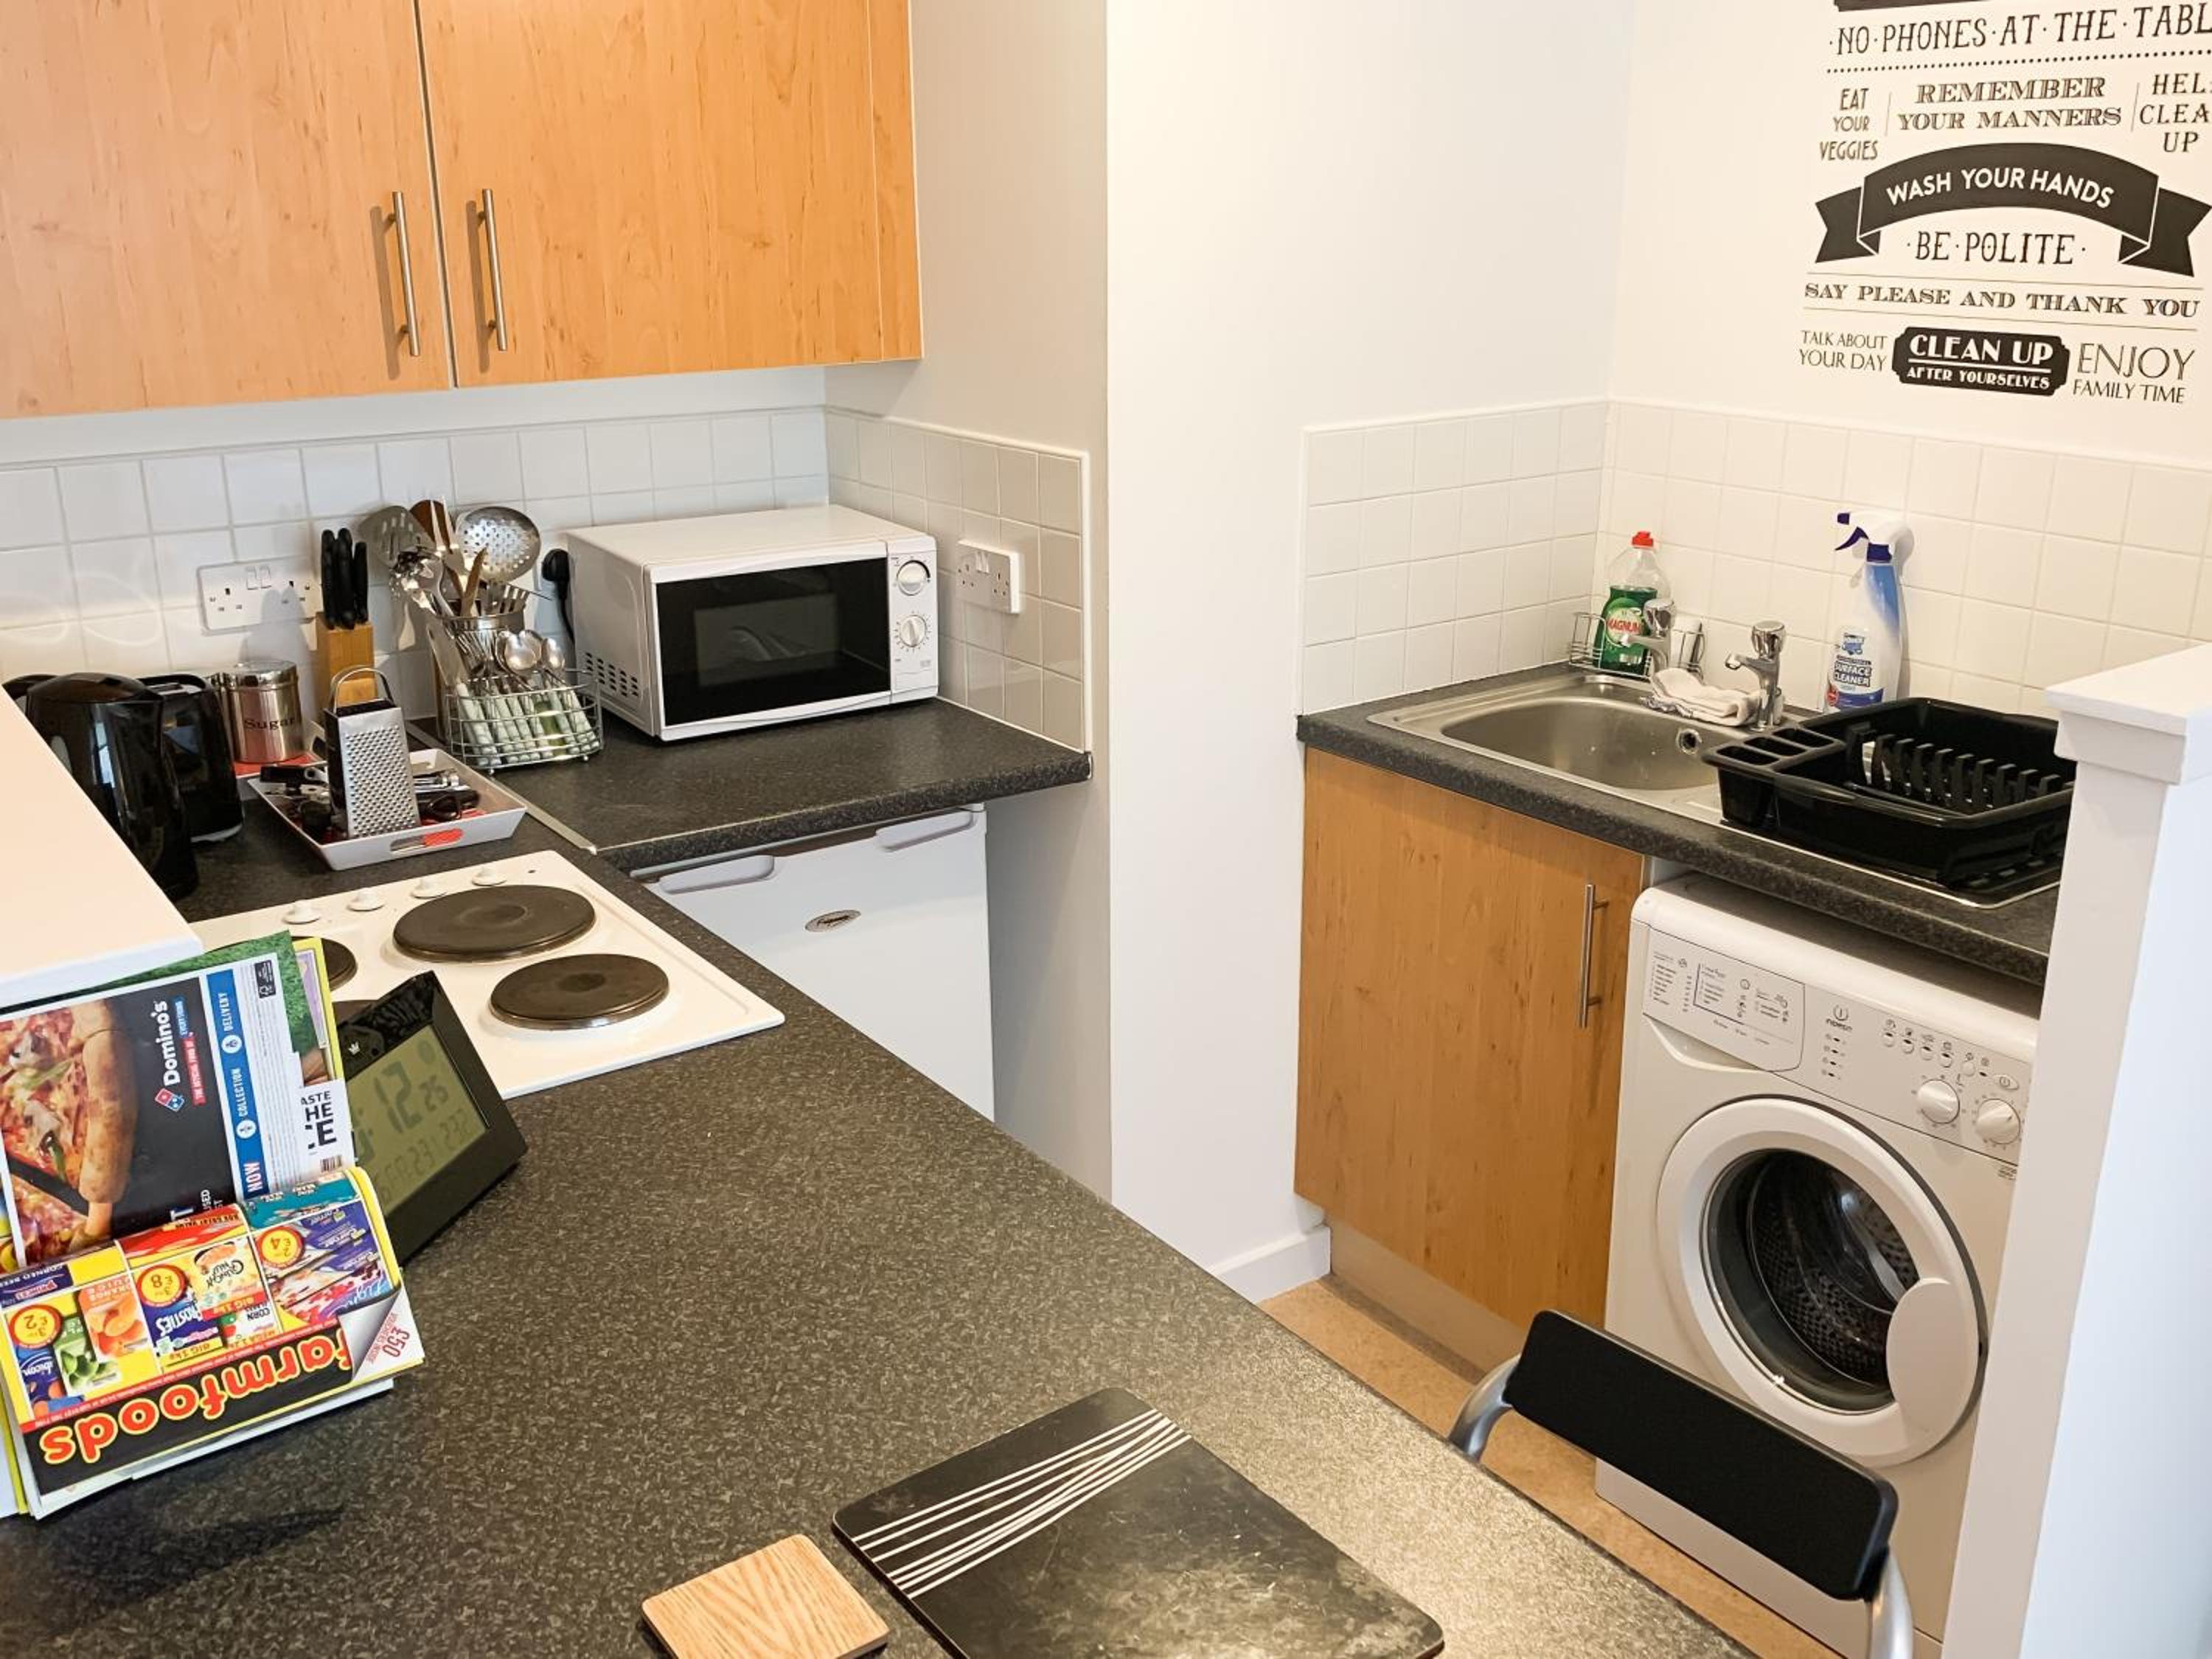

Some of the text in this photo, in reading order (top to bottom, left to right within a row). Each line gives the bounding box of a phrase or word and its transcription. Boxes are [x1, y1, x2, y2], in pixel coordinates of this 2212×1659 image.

[1837, 2, 2212, 55] NO PHONES AT THE TABL
[1916, 76, 2107, 104] REMEMBER
[2152, 72, 2212, 95] HEL
[1840, 88, 1869, 111] EAT
[1833, 115, 1871, 132] YOUR
[1898, 106, 2122, 131] YOUR MANNERS
[2140, 103, 2211, 125] CLEA
[1819, 140, 1879, 161] VEGGIES
[2163, 131, 2199, 153] UP
[1885, 167, 2115, 209] WASH YOUR HANDS
[1915, 231, 2076, 265] BE POLITE
[1804, 282, 2201, 319] SAY PLEASE AND THANK YOU
[1801, 330, 1888, 350] TALK ABOUT
[1909, 334, 2053, 365] CLEAN UP
[1799, 348, 1888, 372] YOUR DAY
[2077, 341, 2195, 380] ENJOY
[1906, 366, 2051, 390] AFTER YOURSELVES
[2073, 379, 2186, 404] FAMILY TIME
[1834, 660, 1872, 678] SURFACE
[1834, 672, 1871, 687] CLEANER
[244, 717, 295, 731] Sugar
[218, 992, 234, 1032] DELIVERY
[150, 1001, 181, 1086] Domino's
[232, 1068, 248, 1116] COLLECTION
[301, 1091, 331, 1105] ASTE
[305, 1102, 333, 1121] HE
[243, 1161, 263, 1192] NOW
[247, 1307, 271, 1321] CORN
[382, 1327, 410, 1358] £50
